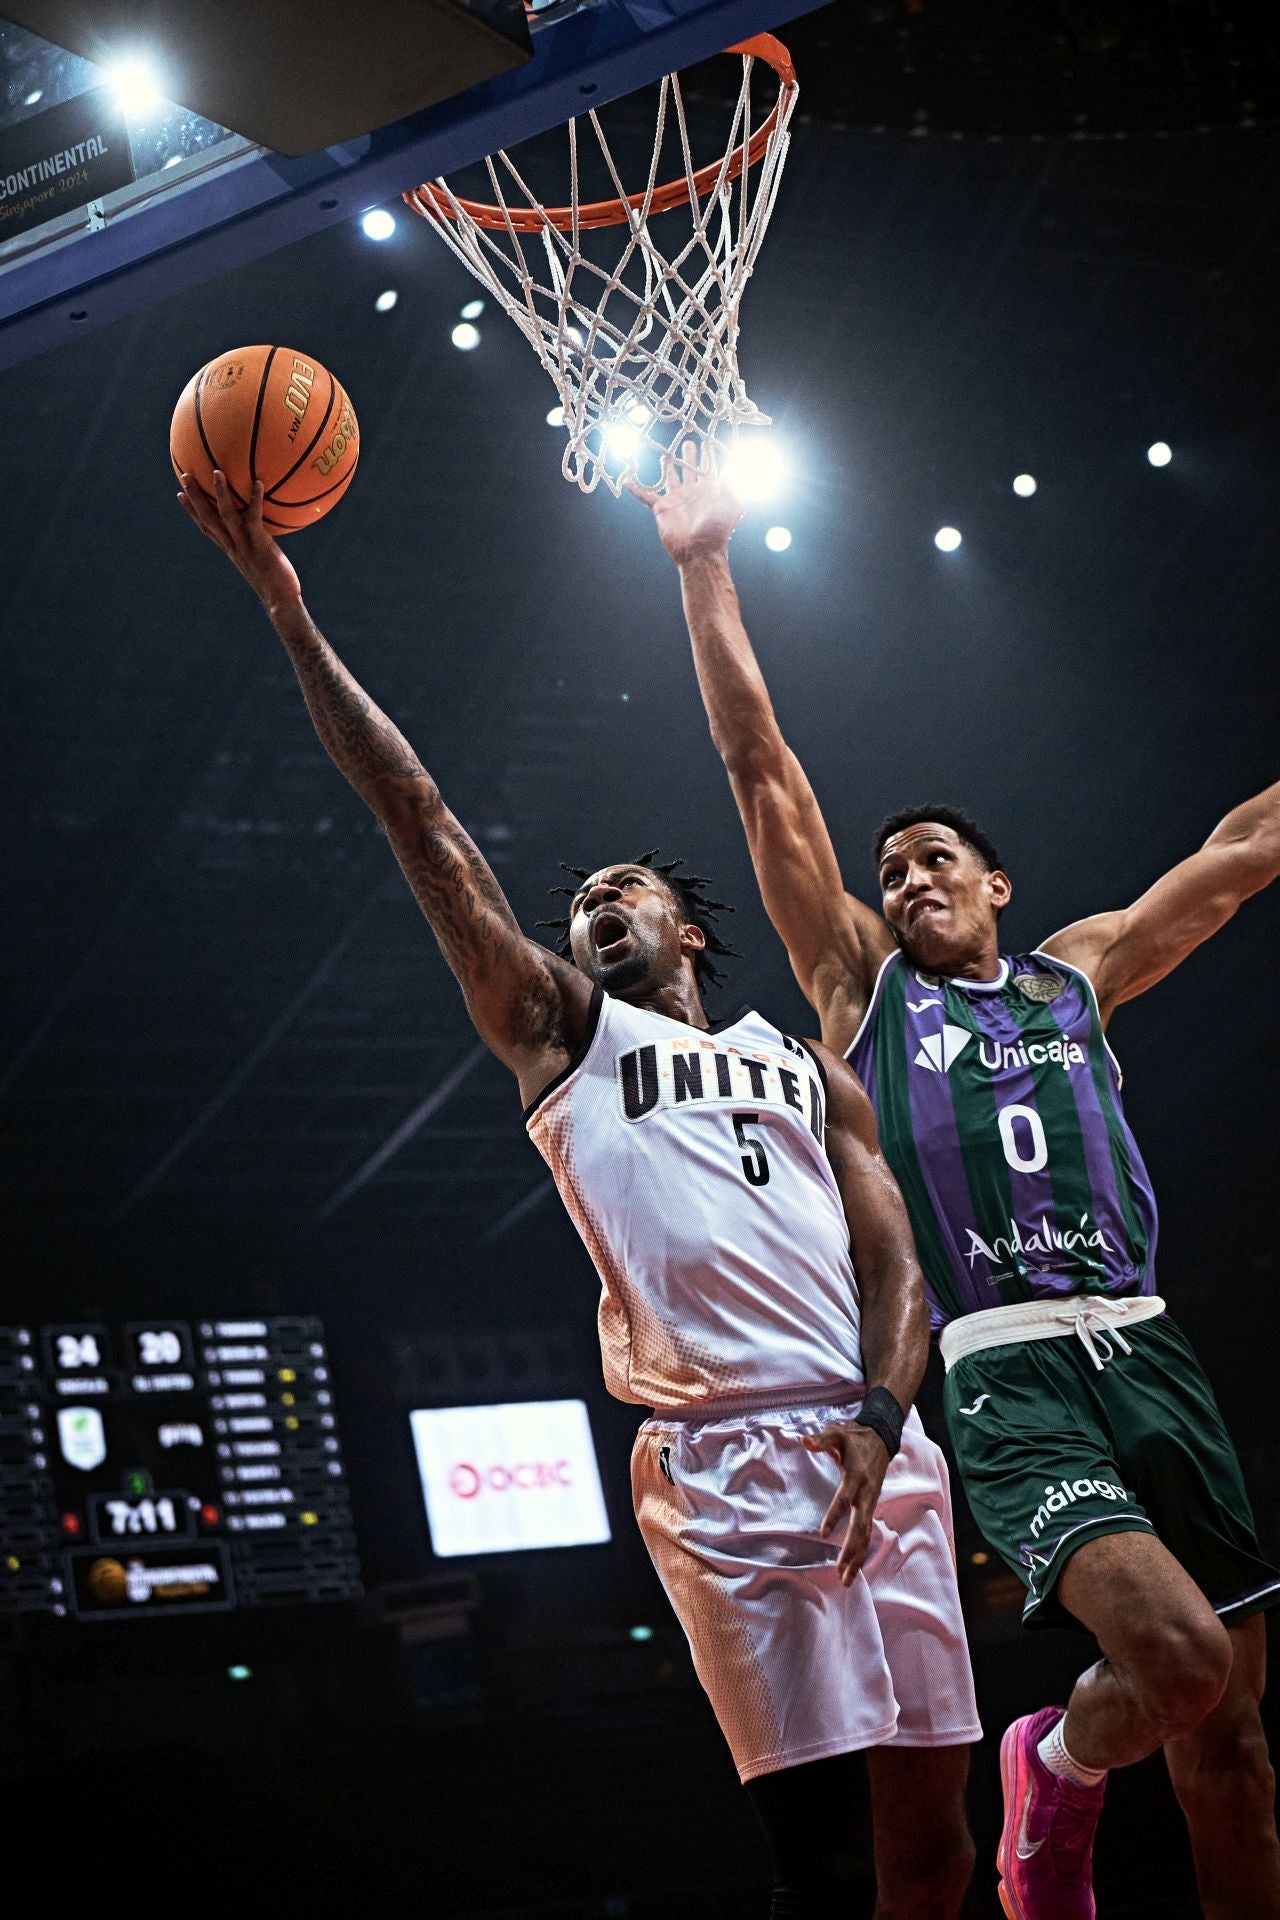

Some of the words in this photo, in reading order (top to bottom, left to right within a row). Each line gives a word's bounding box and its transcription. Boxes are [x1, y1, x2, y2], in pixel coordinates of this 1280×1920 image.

[0, 135, 108, 200] CONTINENTAL
[58, 169, 88, 191] 2024
[285, 358, 315, 419] EVO
[287, 416, 301, 443] NXT
[979, 1034, 1085, 1071] Unicaja
[732, 1113, 769, 1186] 5
[998, 1104, 1048, 1173] 0
[964, 1213, 1115, 1269] Andalucía
